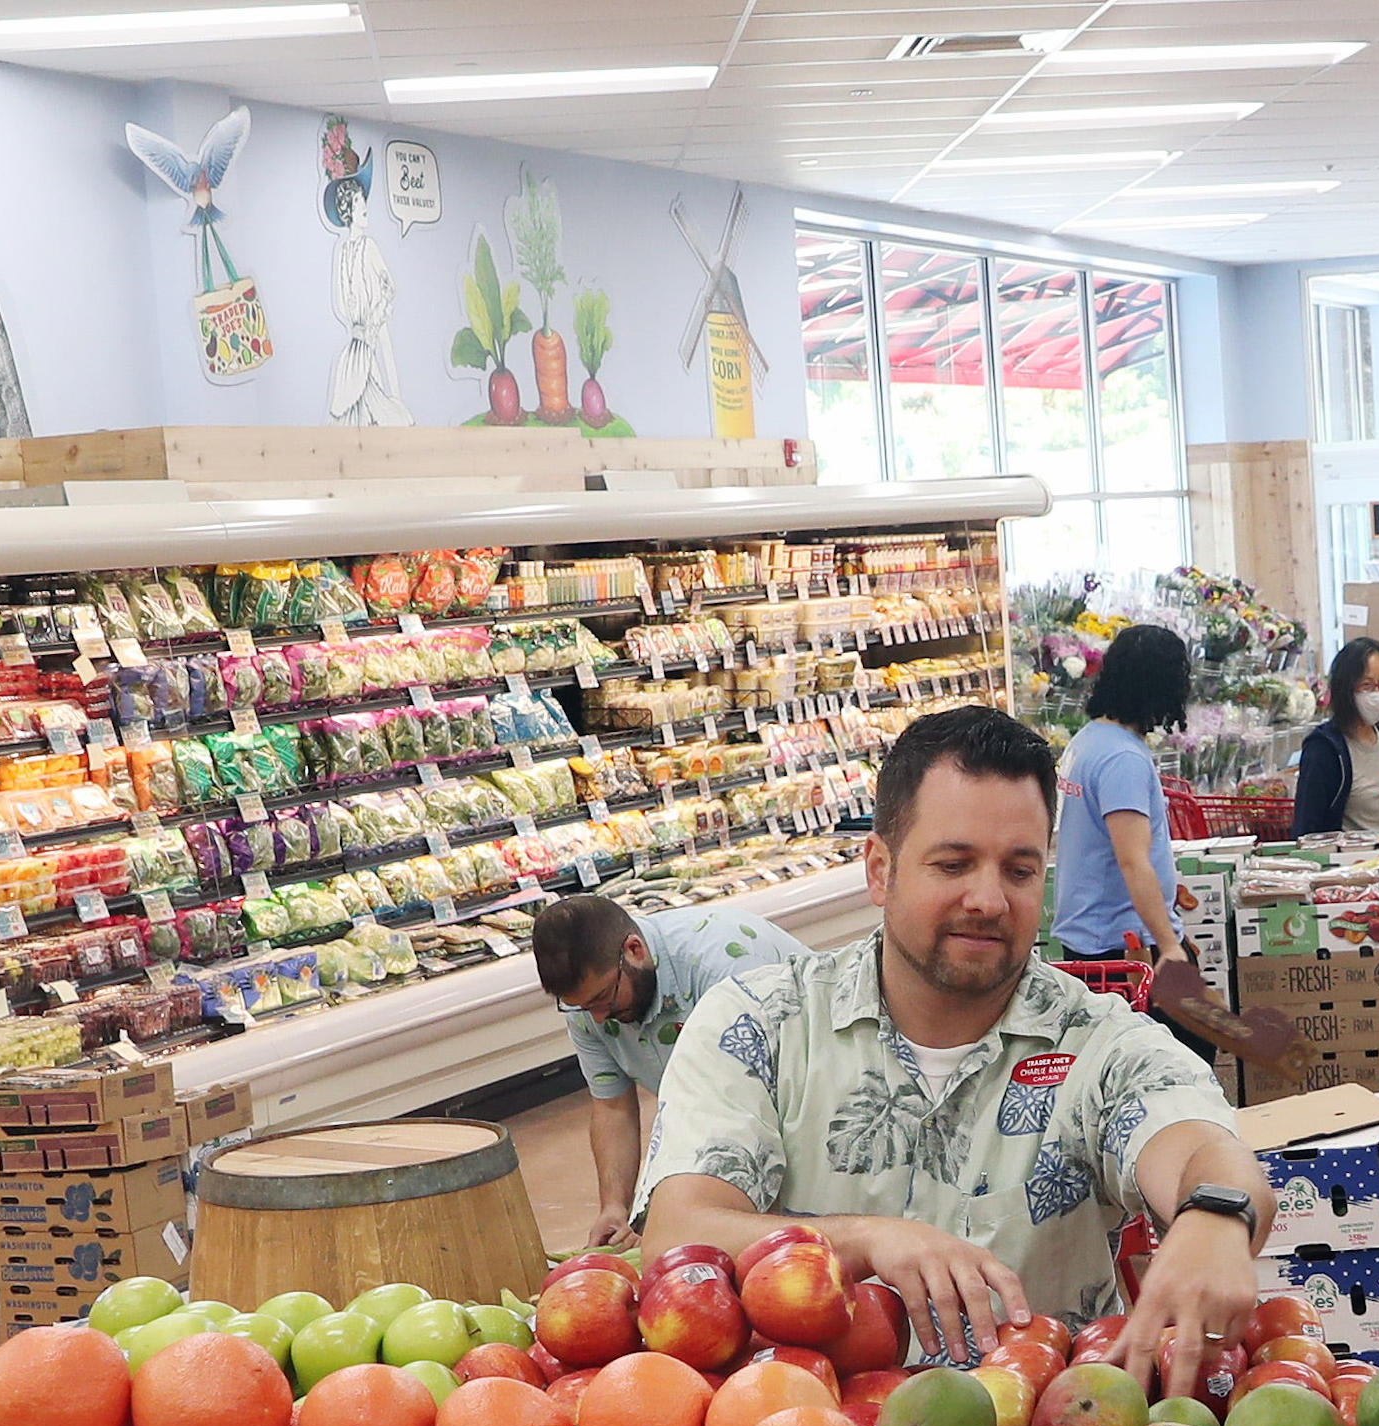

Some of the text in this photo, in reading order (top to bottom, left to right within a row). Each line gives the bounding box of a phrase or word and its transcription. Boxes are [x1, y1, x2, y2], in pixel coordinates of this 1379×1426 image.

[211, 302, 245, 328] TRADER
[712, 358, 742, 380] CORN
[1287, 966, 1332, 993] FRESH
[1345, 969, 1367, 983] FROM
[1026, 1055, 1071, 1068] TRADER JOE'S
[0, 1241, 53, 1251] WASHINGTON
